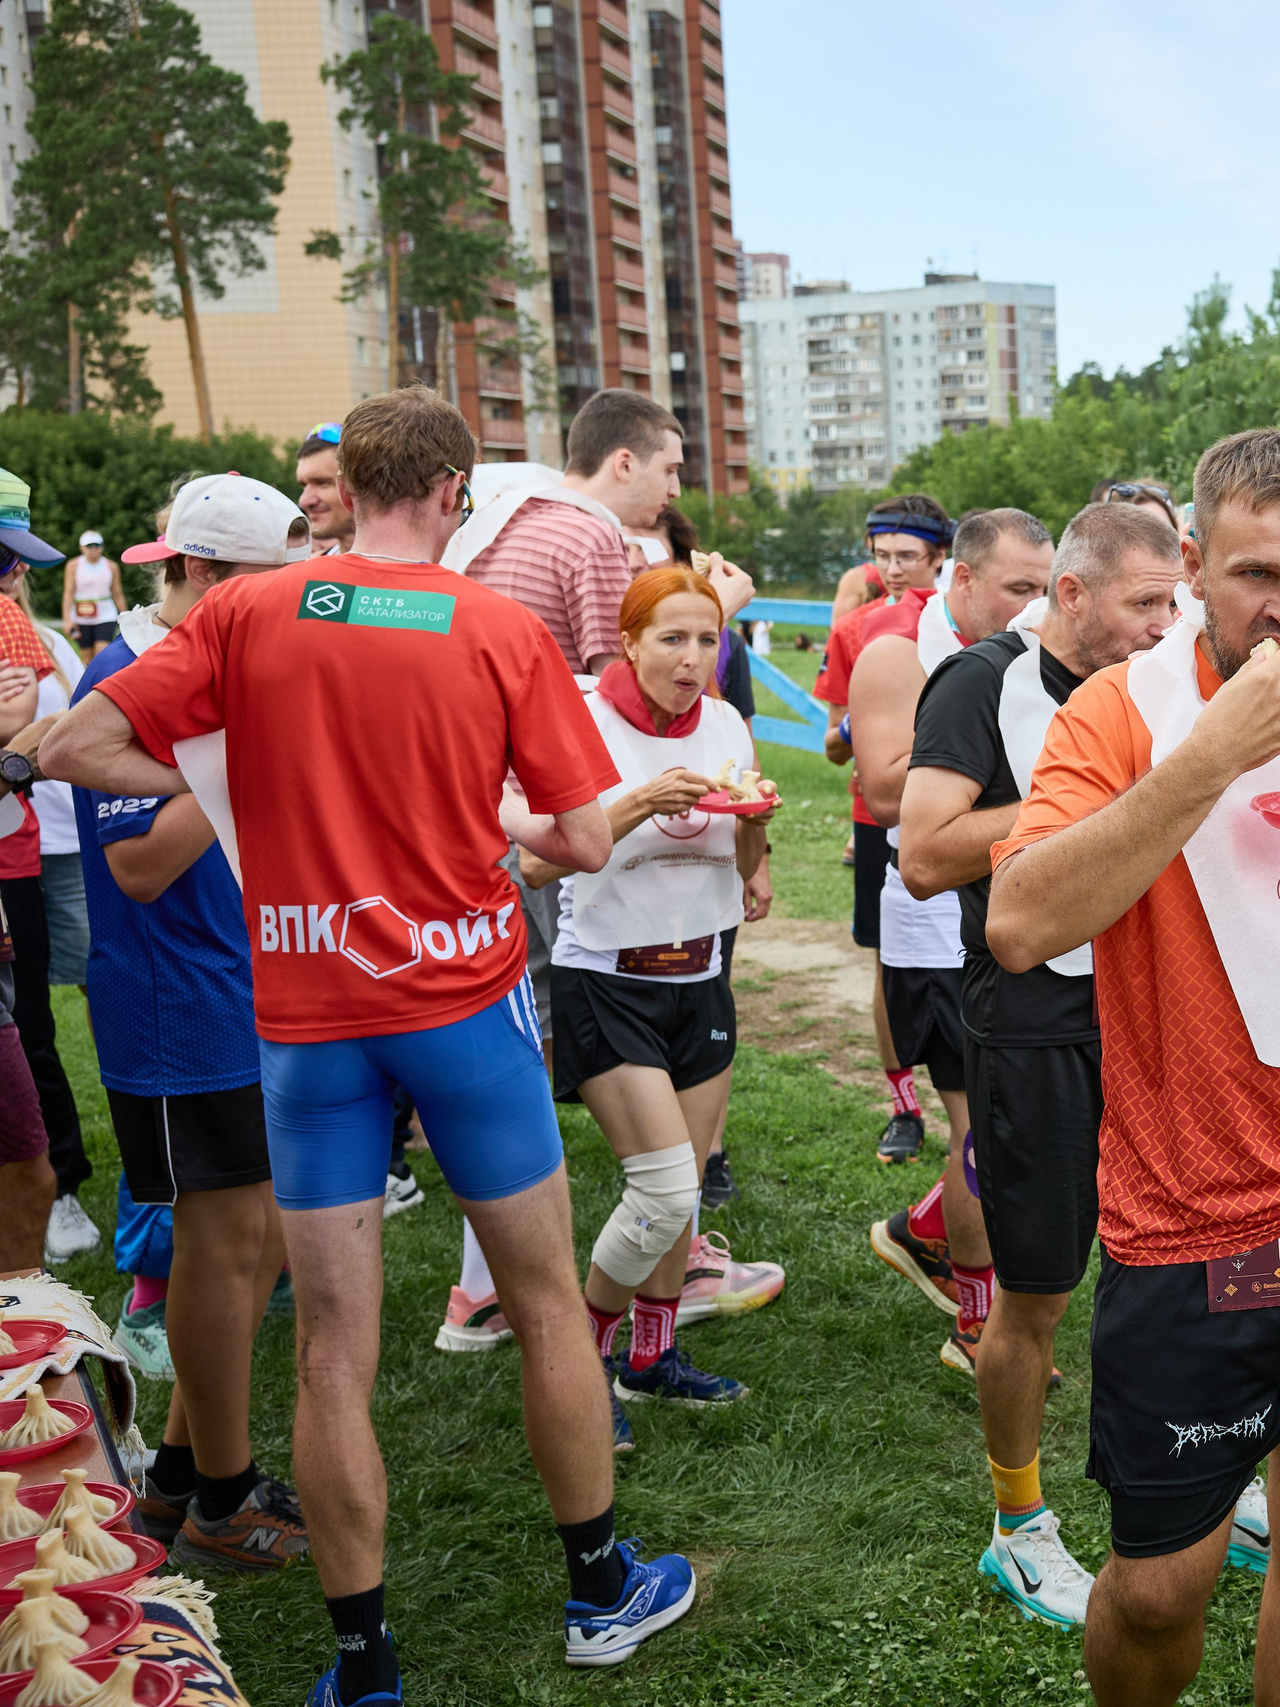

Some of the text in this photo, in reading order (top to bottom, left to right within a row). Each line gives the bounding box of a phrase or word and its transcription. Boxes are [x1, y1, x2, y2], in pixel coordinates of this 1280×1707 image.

[184, 543, 216, 556] adidas
[360, 595, 405, 607] СКТБ
[357, 606, 446, 622] КАТАЛИЗАТОР
[259, 904, 340, 953] ВПК
[711, 1029, 728, 1041] Run
